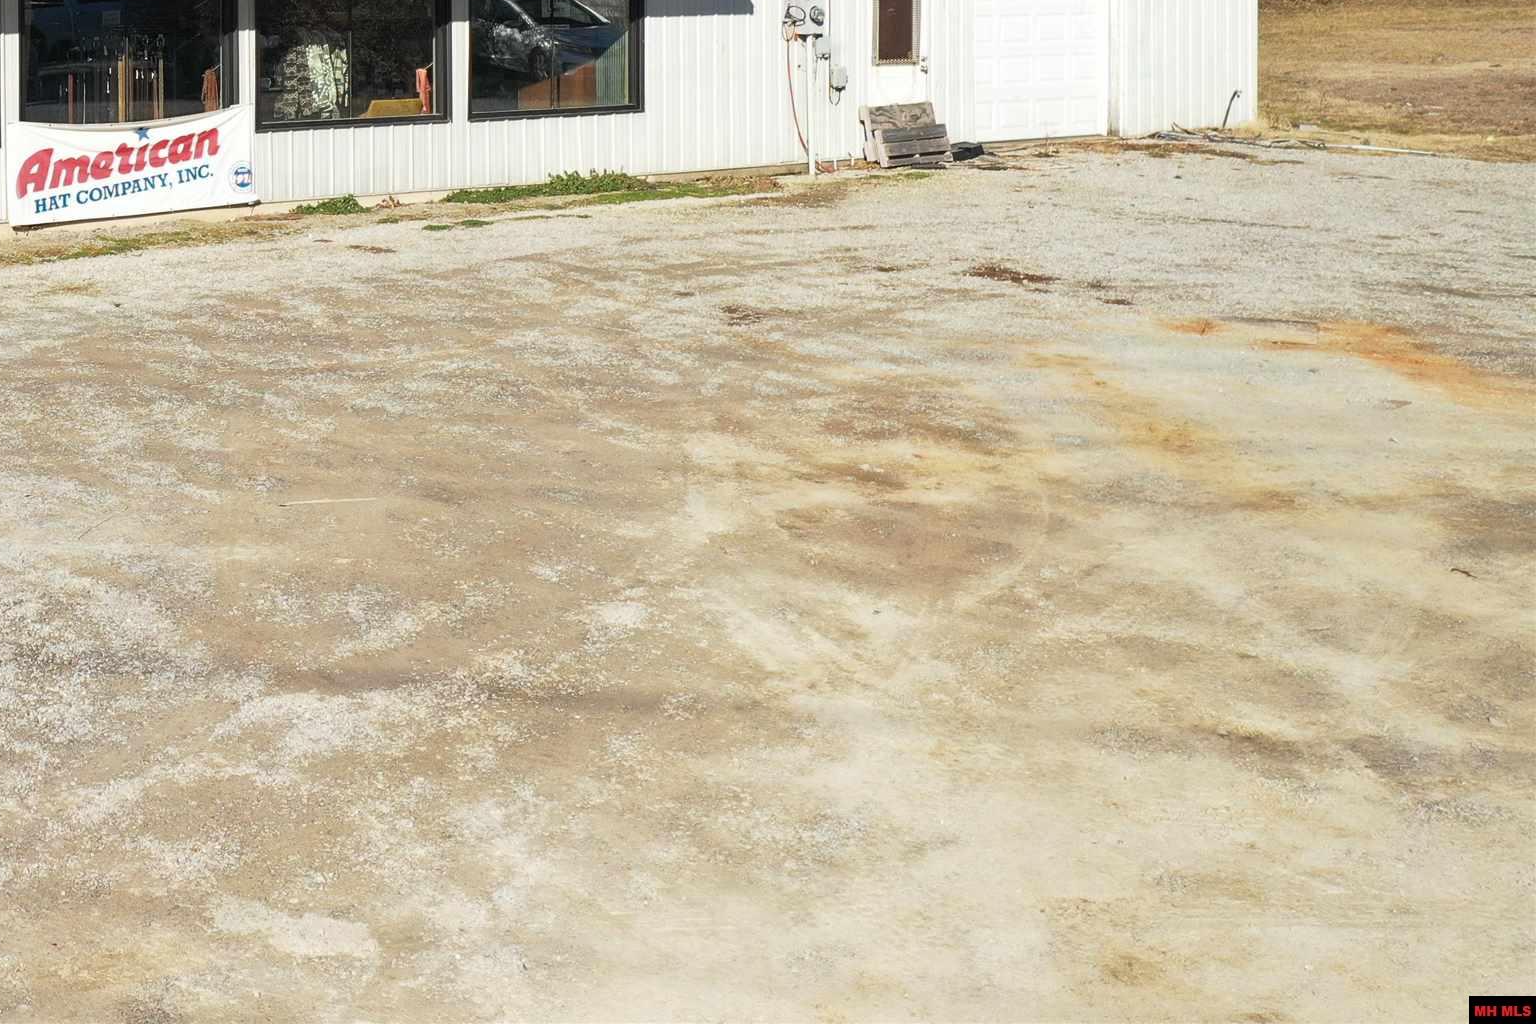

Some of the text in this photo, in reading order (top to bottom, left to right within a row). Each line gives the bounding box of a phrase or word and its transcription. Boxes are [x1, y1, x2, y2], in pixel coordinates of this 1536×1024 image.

[16, 127, 220, 199] American
[34, 193, 71, 214] HAT
[76, 173, 173, 205] COMPANY,
[177, 164, 214, 184] INC.
